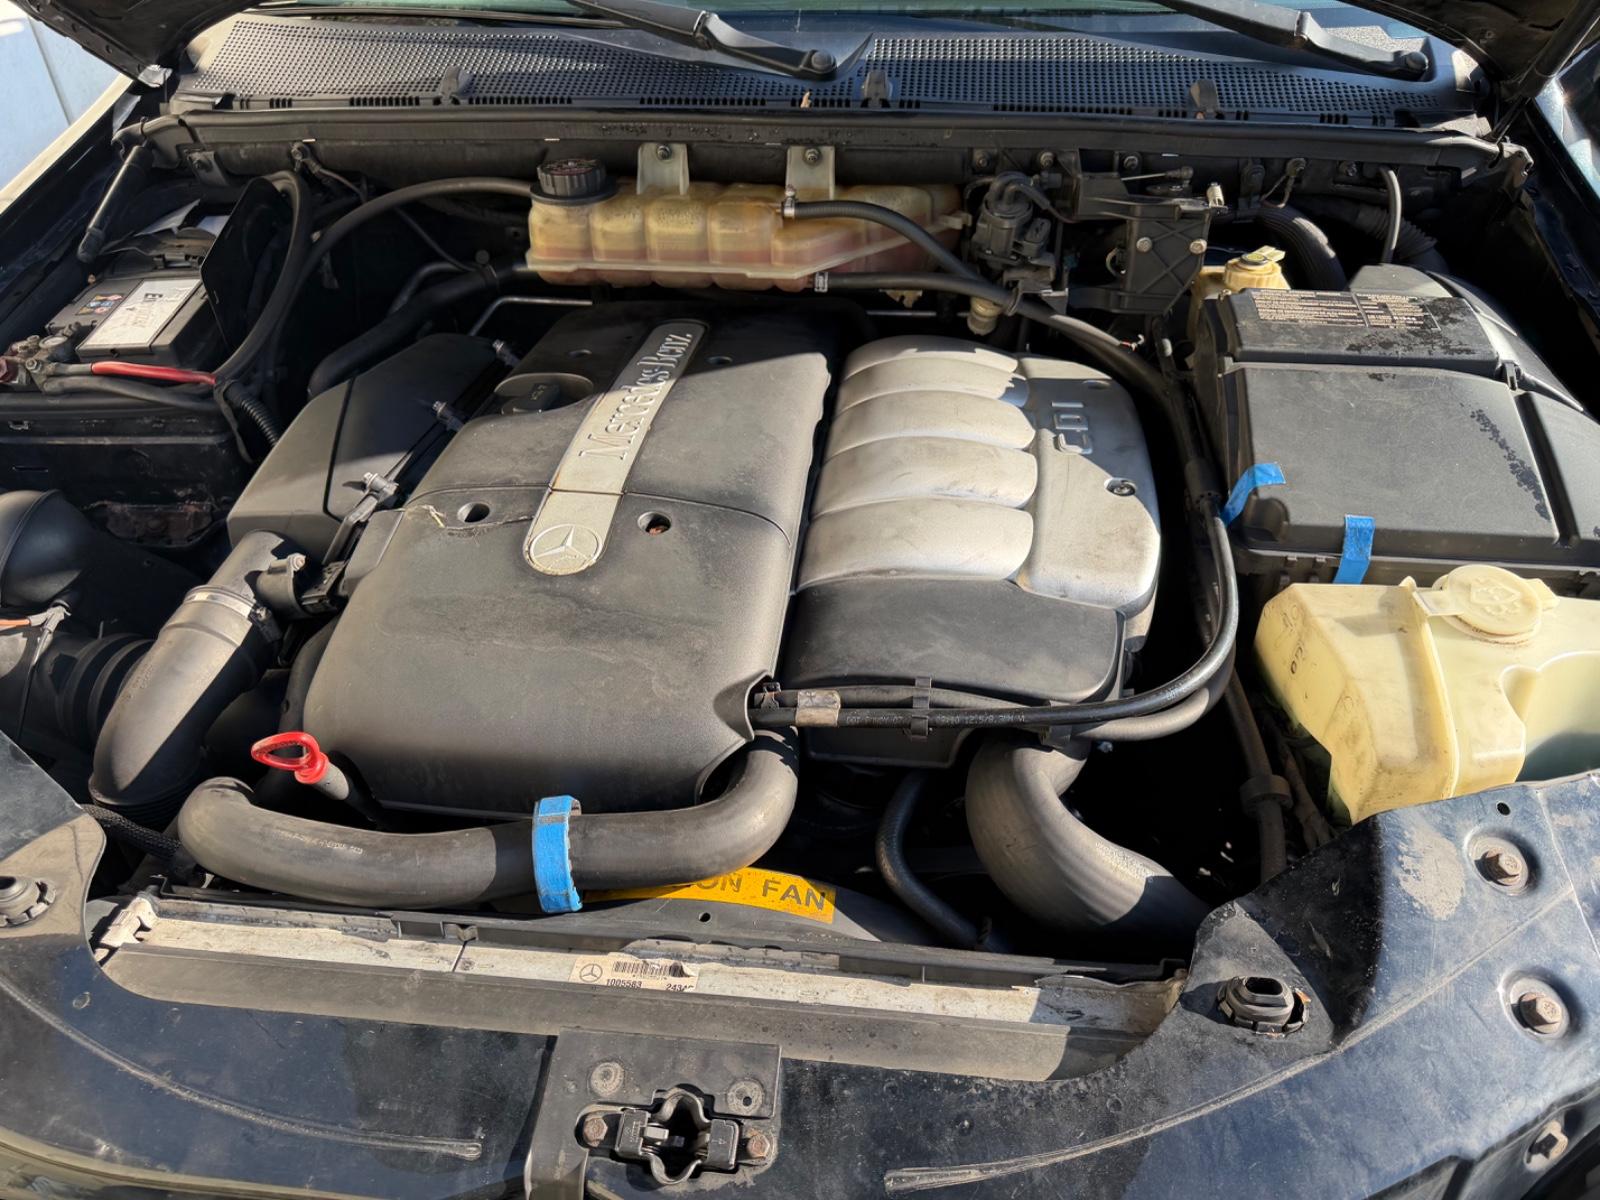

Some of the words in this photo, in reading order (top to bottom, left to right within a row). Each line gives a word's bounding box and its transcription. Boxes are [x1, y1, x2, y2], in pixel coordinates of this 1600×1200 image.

[579, 333, 692, 460] Mercedes-Benz
[1051, 401, 1093, 455] CDI
[762, 878, 825, 911] FAN
